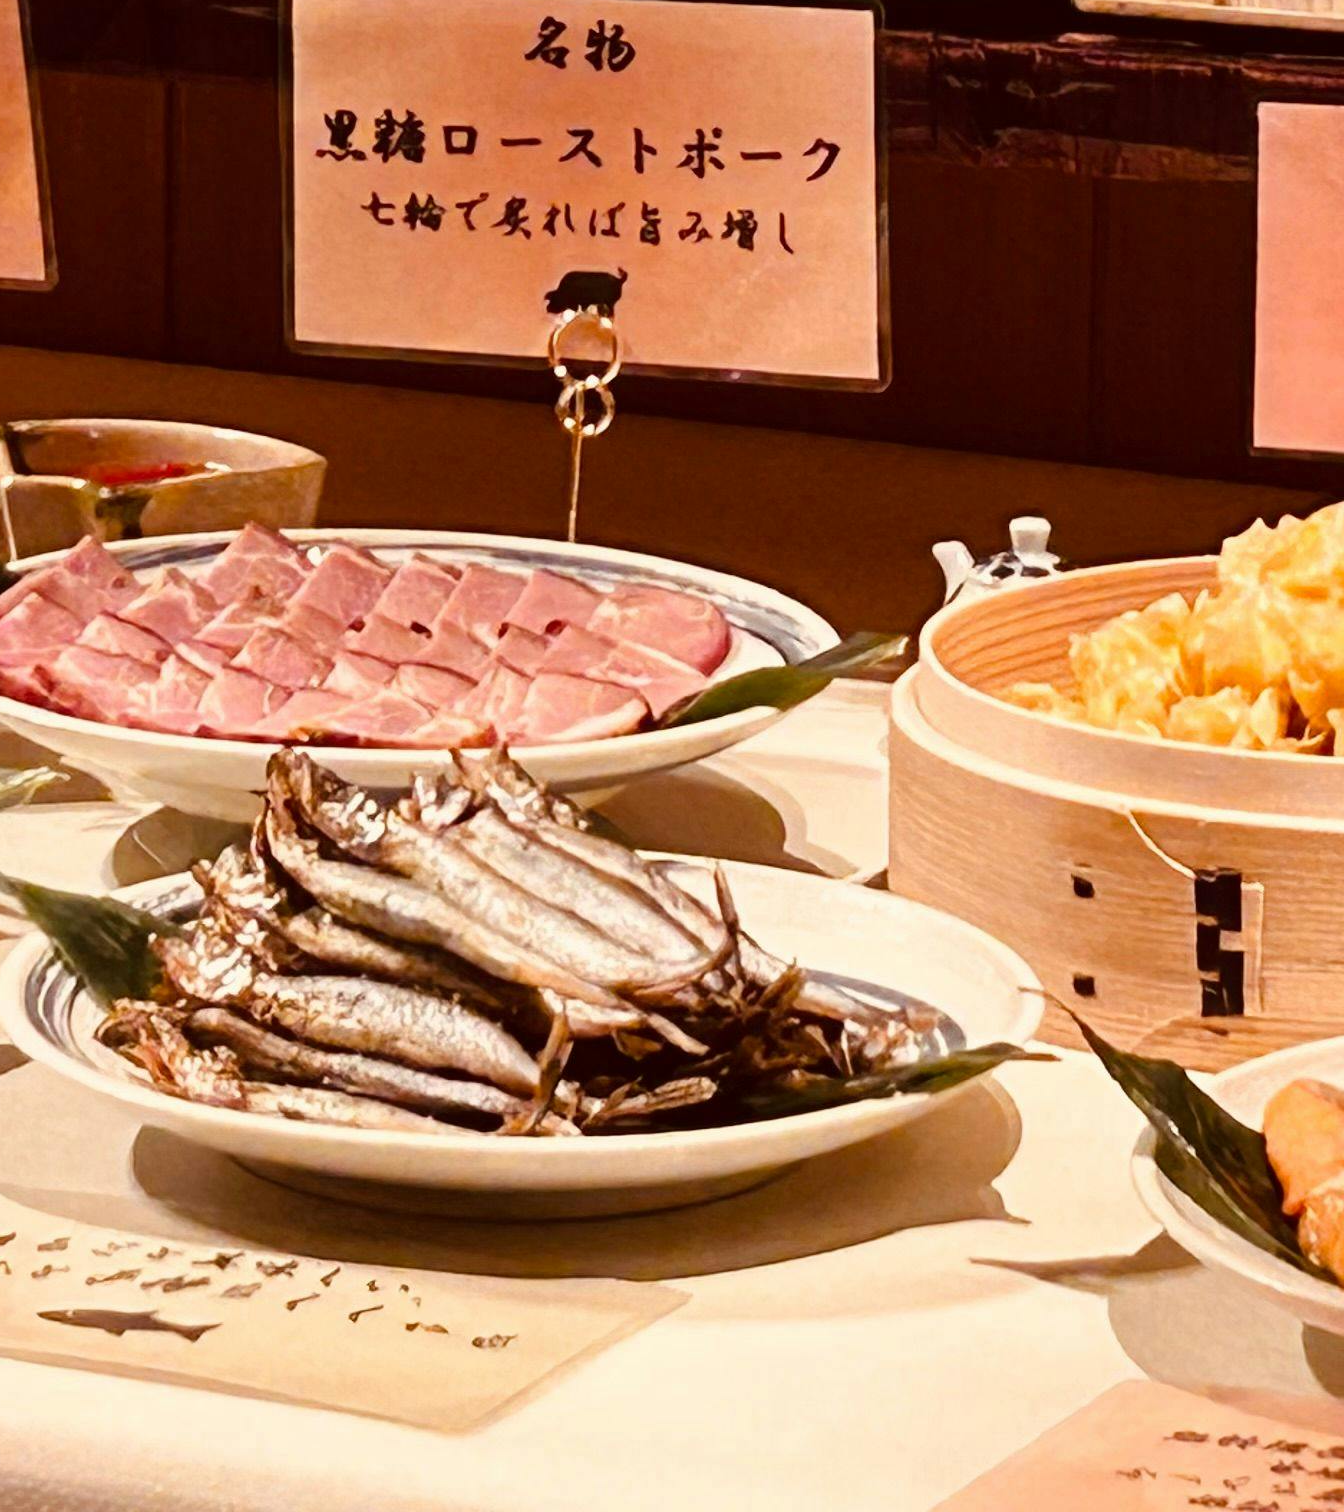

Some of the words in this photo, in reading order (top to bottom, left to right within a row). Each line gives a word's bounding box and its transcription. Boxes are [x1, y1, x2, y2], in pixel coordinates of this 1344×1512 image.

[524, 16, 636, 72] 名物
[315, 109, 840, 181] 黒糖ローストポーク
[361, 191, 794, 254] 七輪で炙れば旨み増し
